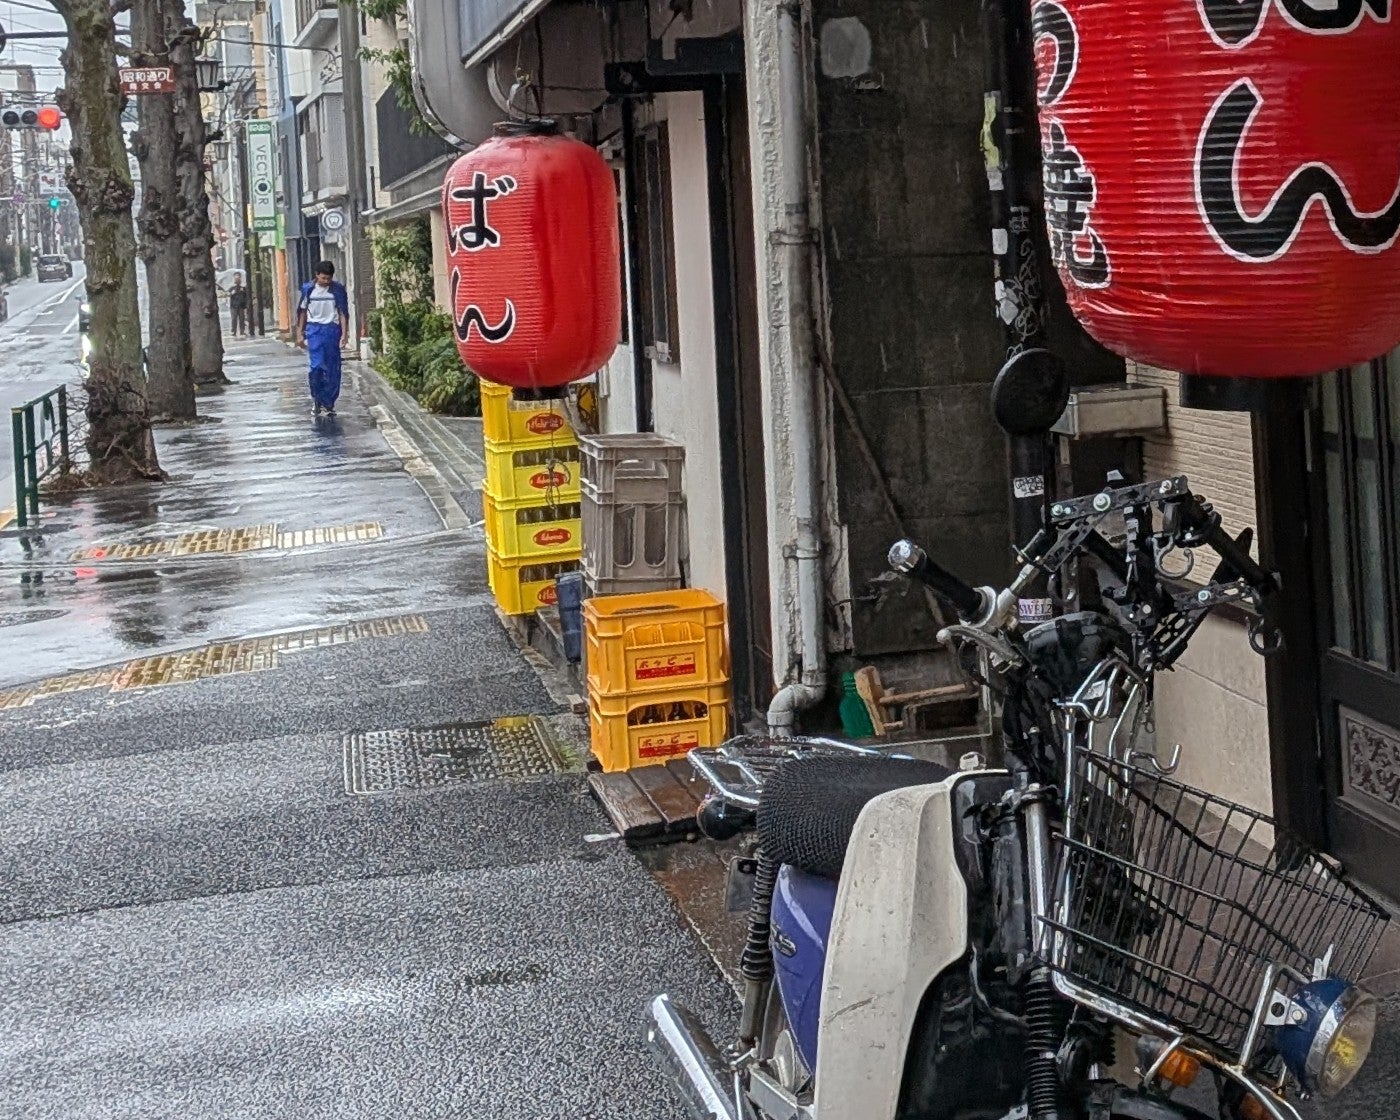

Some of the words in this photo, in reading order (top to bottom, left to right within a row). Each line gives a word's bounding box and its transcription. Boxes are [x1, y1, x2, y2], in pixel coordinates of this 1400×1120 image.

[123, 70, 167, 83] 昭和通り
[254, 144, 272, 206] VECTOR
[442, 171, 517, 343] ばん
